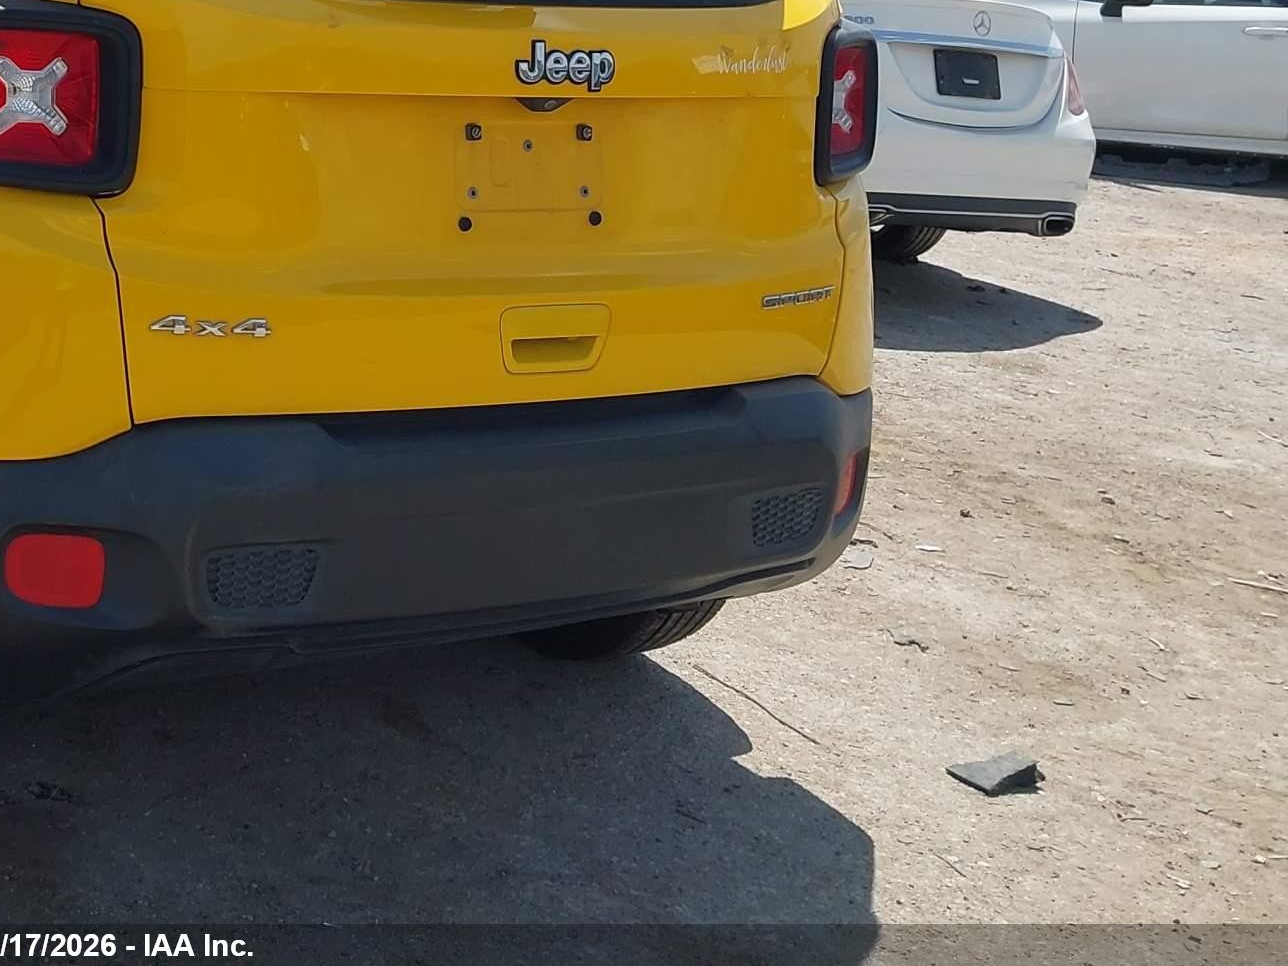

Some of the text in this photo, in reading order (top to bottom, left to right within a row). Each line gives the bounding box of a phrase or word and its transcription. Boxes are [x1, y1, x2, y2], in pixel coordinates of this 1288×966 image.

[516, 40, 615, 92] Jeep
[762, 285, 836, 310] SPORT
[149, 314, 273, 338] 4x4
